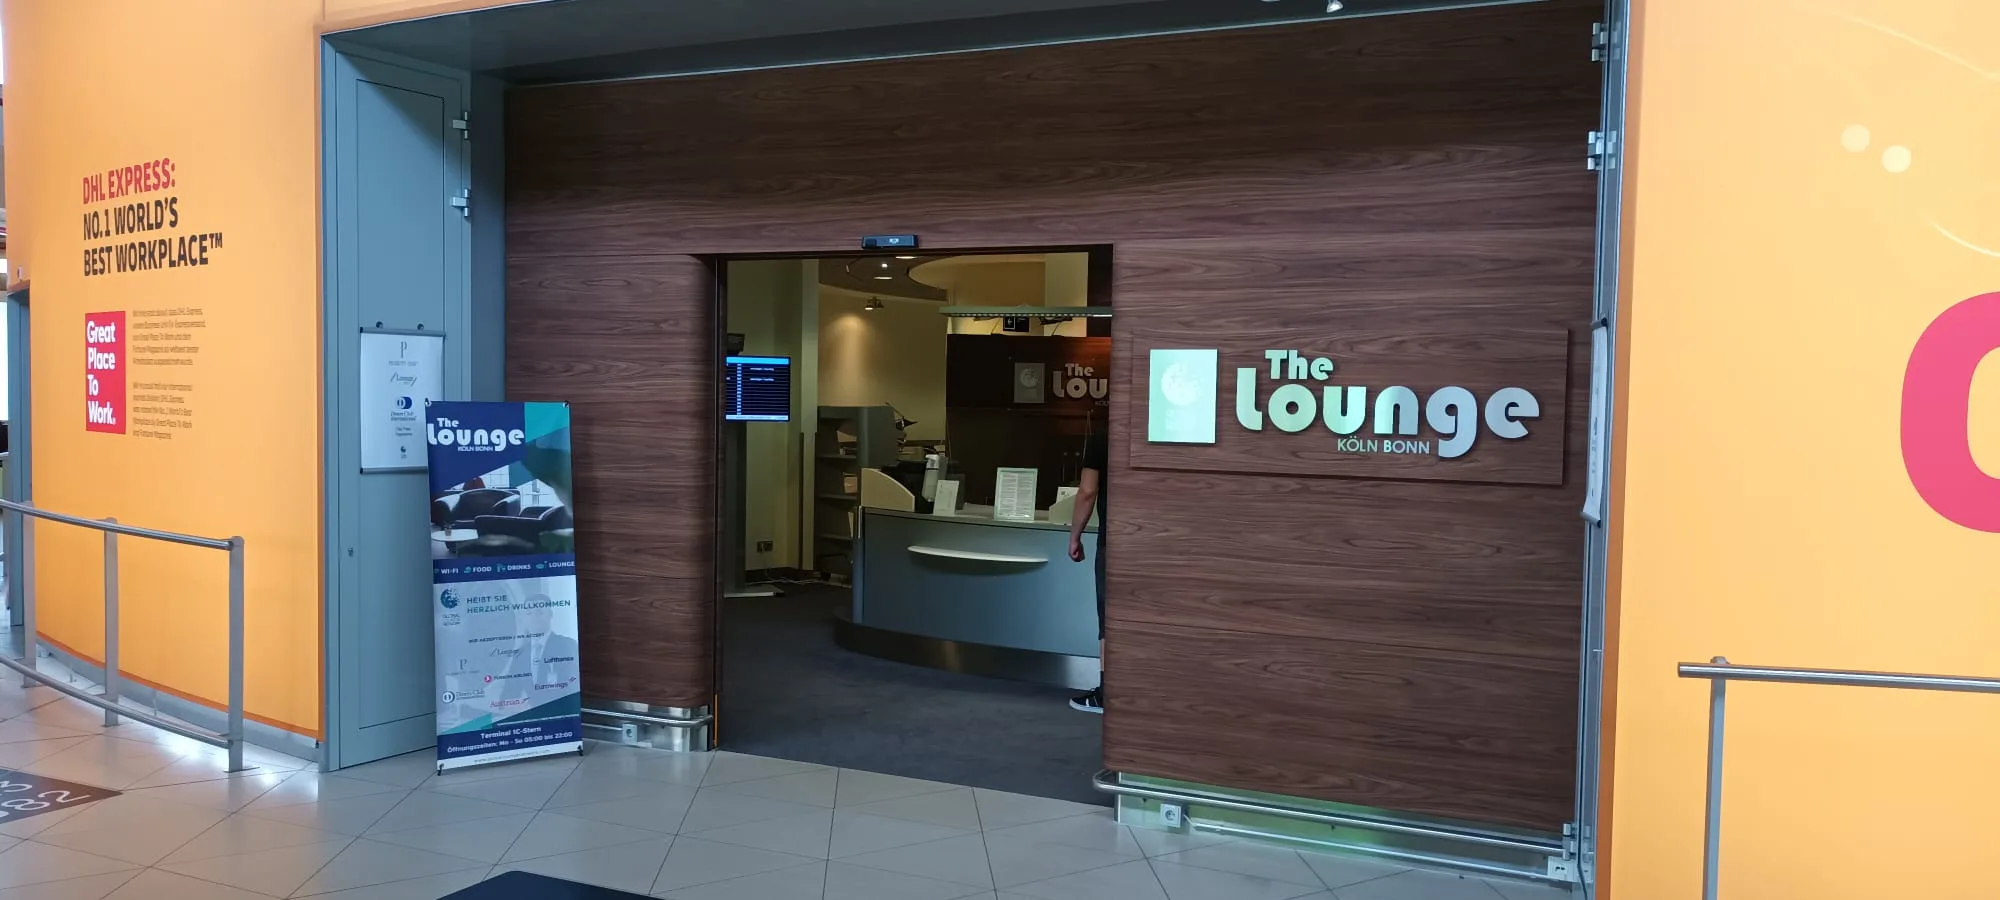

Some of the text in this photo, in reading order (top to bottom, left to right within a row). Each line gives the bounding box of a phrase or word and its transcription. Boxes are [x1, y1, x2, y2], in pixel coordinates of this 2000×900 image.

[83, 157, 176, 204] DHL EXPRESS:
[83, 209, 111, 240] NO.1
[84, 245, 113, 276] BEST
[87, 320, 116, 344] Great
[88, 347, 115, 371] Place
[1264, 349, 1334, 381] The
[1065, 363, 1094, 378] The
[87, 374, 99, 396] To
[1236, 367, 1540, 459] Lounge
[437, 417, 459, 428] The
[427, 423, 524, 452] Lounge
[1337, 435, 1431, 455] KÖLN BONN
[440, 567, 459, 575] WI-FI
[472, 565, 492, 573] FOOD
[507, 563, 531, 571] DRINKS
[549, 560, 575, 568] LOUNGE
[466, 599, 571, 614] HERZLICH WILLKOMMEN
[494, 594, 508, 602] SIE
[534, 681, 568, 691] Eurowings
[480, 730, 511, 740] Terminal
